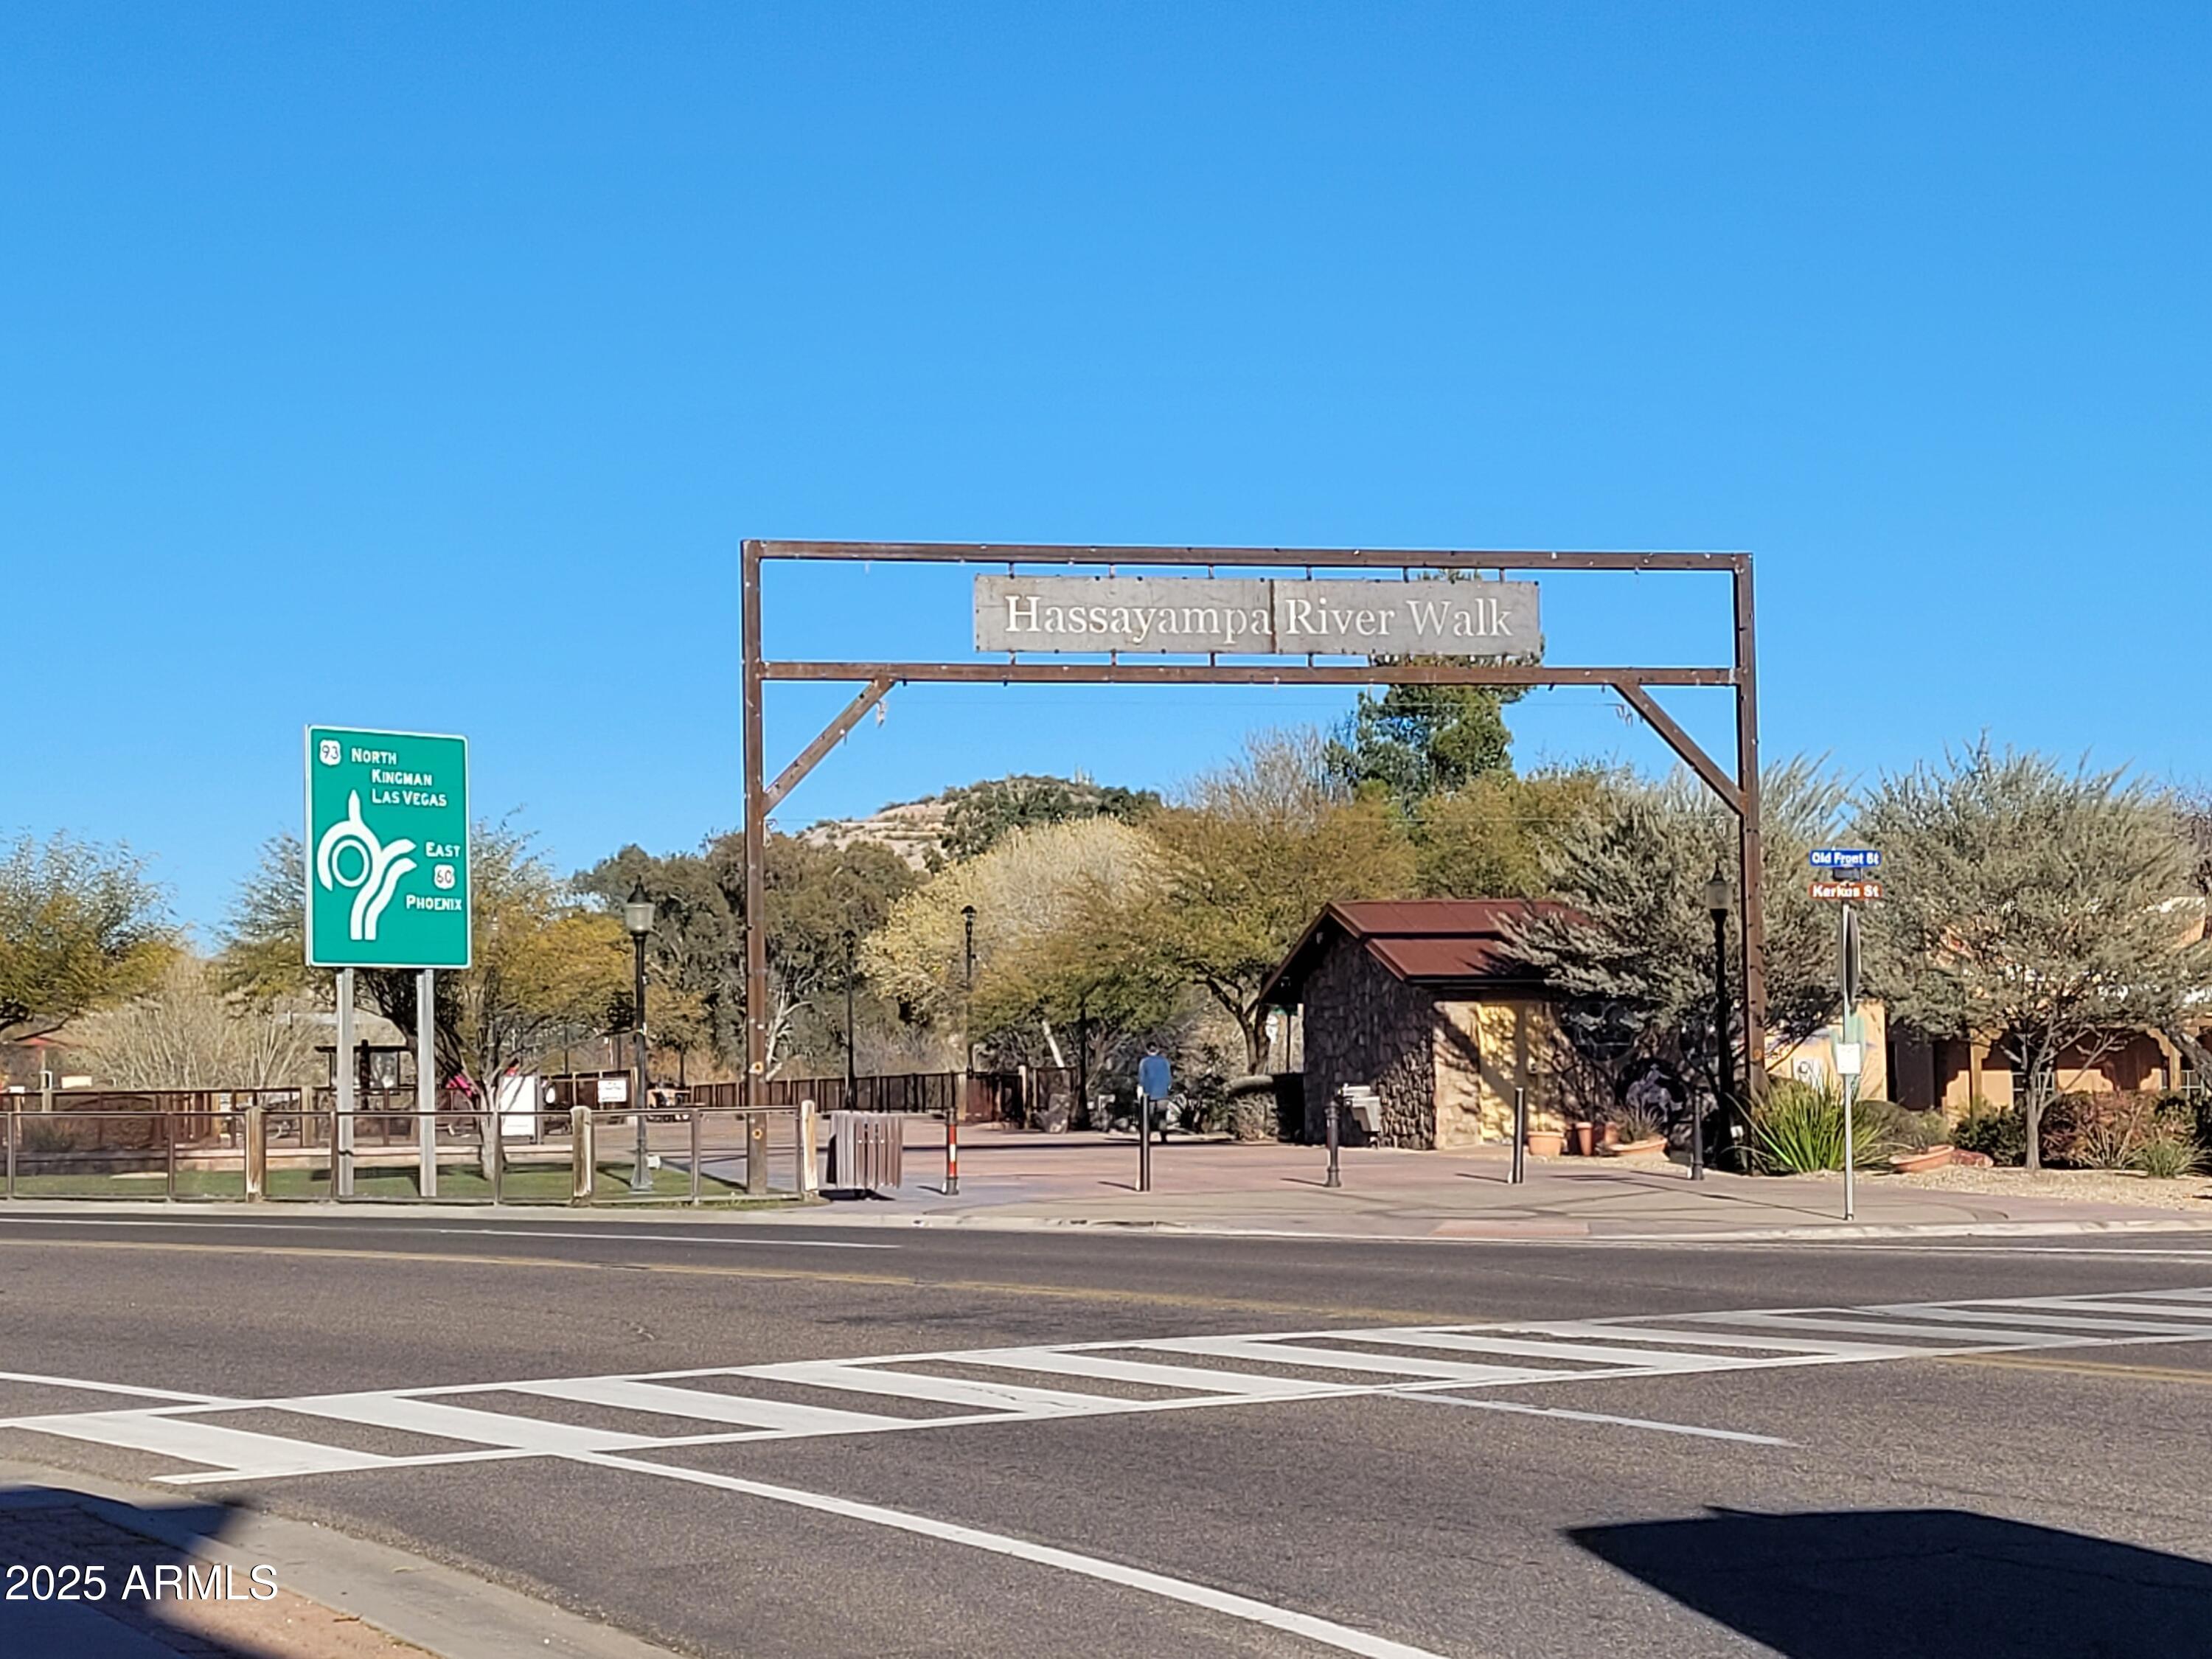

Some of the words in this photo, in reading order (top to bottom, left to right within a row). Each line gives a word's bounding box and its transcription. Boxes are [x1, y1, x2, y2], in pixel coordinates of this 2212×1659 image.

[1004, 594, 1273, 644] Hassayampa
[1285, 597, 1396, 636] River
[1406, 598, 1514, 636] Walk
[321, 745, 339, 759] 93
[351, 748, 397, 765] NORTH
[425, 841, 461, 858] EAST
[1812, 852, 1832, 864] Old
[1834, 852, 1864, 866] Front
[1867, 852, 1879, 866] St
[436, 869, 452, 883] 60
[1864, 884, 1879, 897] St
[406, 894, 462, 911] PHOENIX
